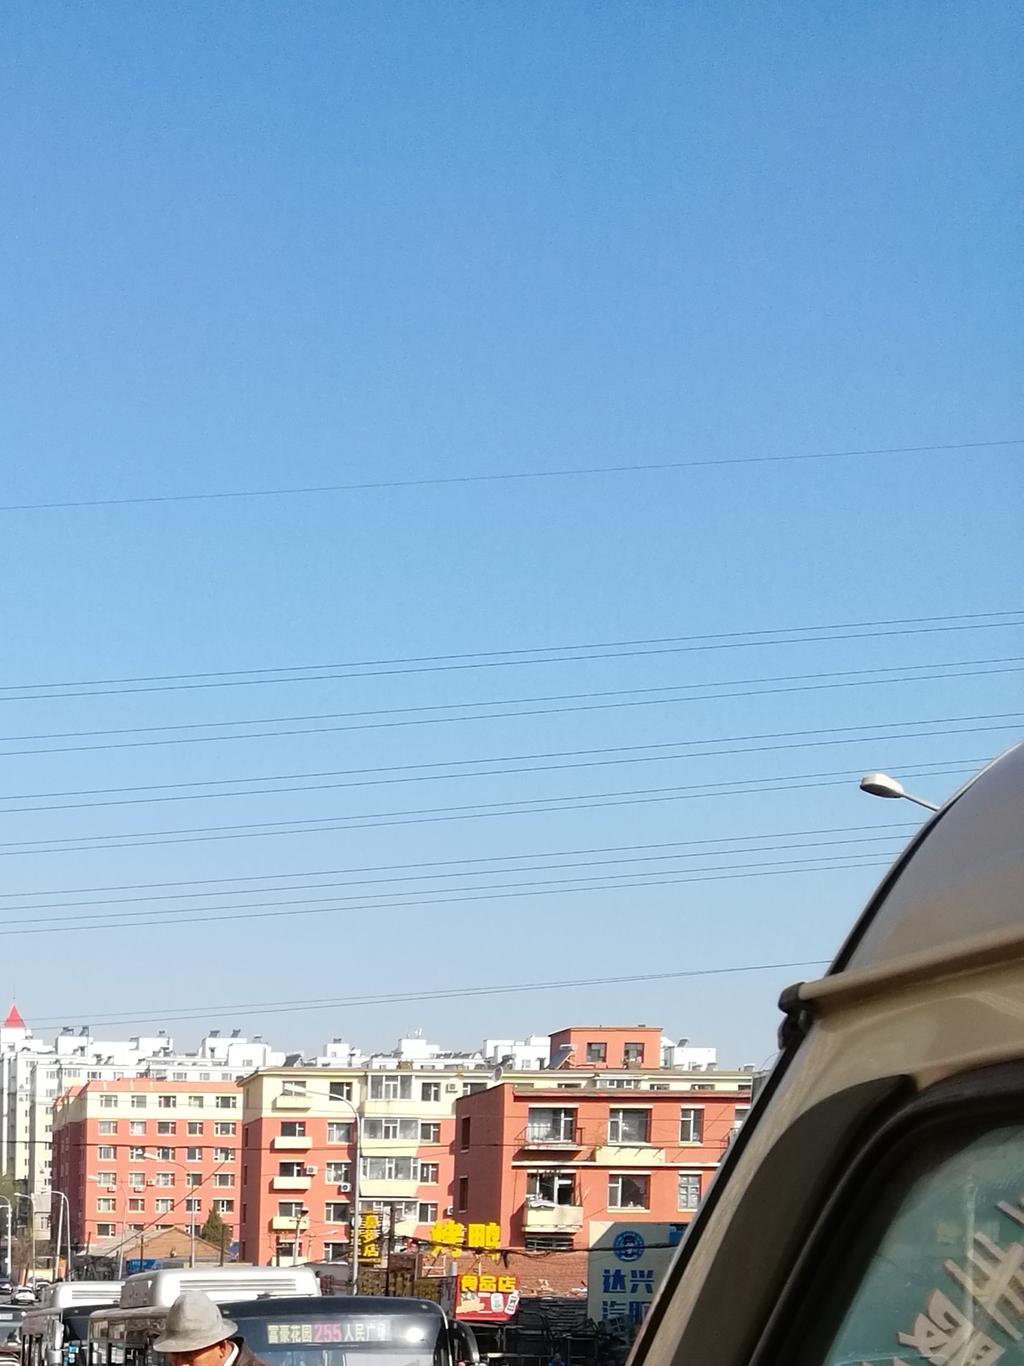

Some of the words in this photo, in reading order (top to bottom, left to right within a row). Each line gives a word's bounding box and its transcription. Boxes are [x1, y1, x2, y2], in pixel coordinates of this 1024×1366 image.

[431, 1219, 501, 1262] 烤鸭
[461, 1275, 516, 1293] 食品店
[602, 1268, 655, 1294] 达兴
[268, 1324, 313, 1344] 富豪花园
[314, 1324, 342, 1343] 255
